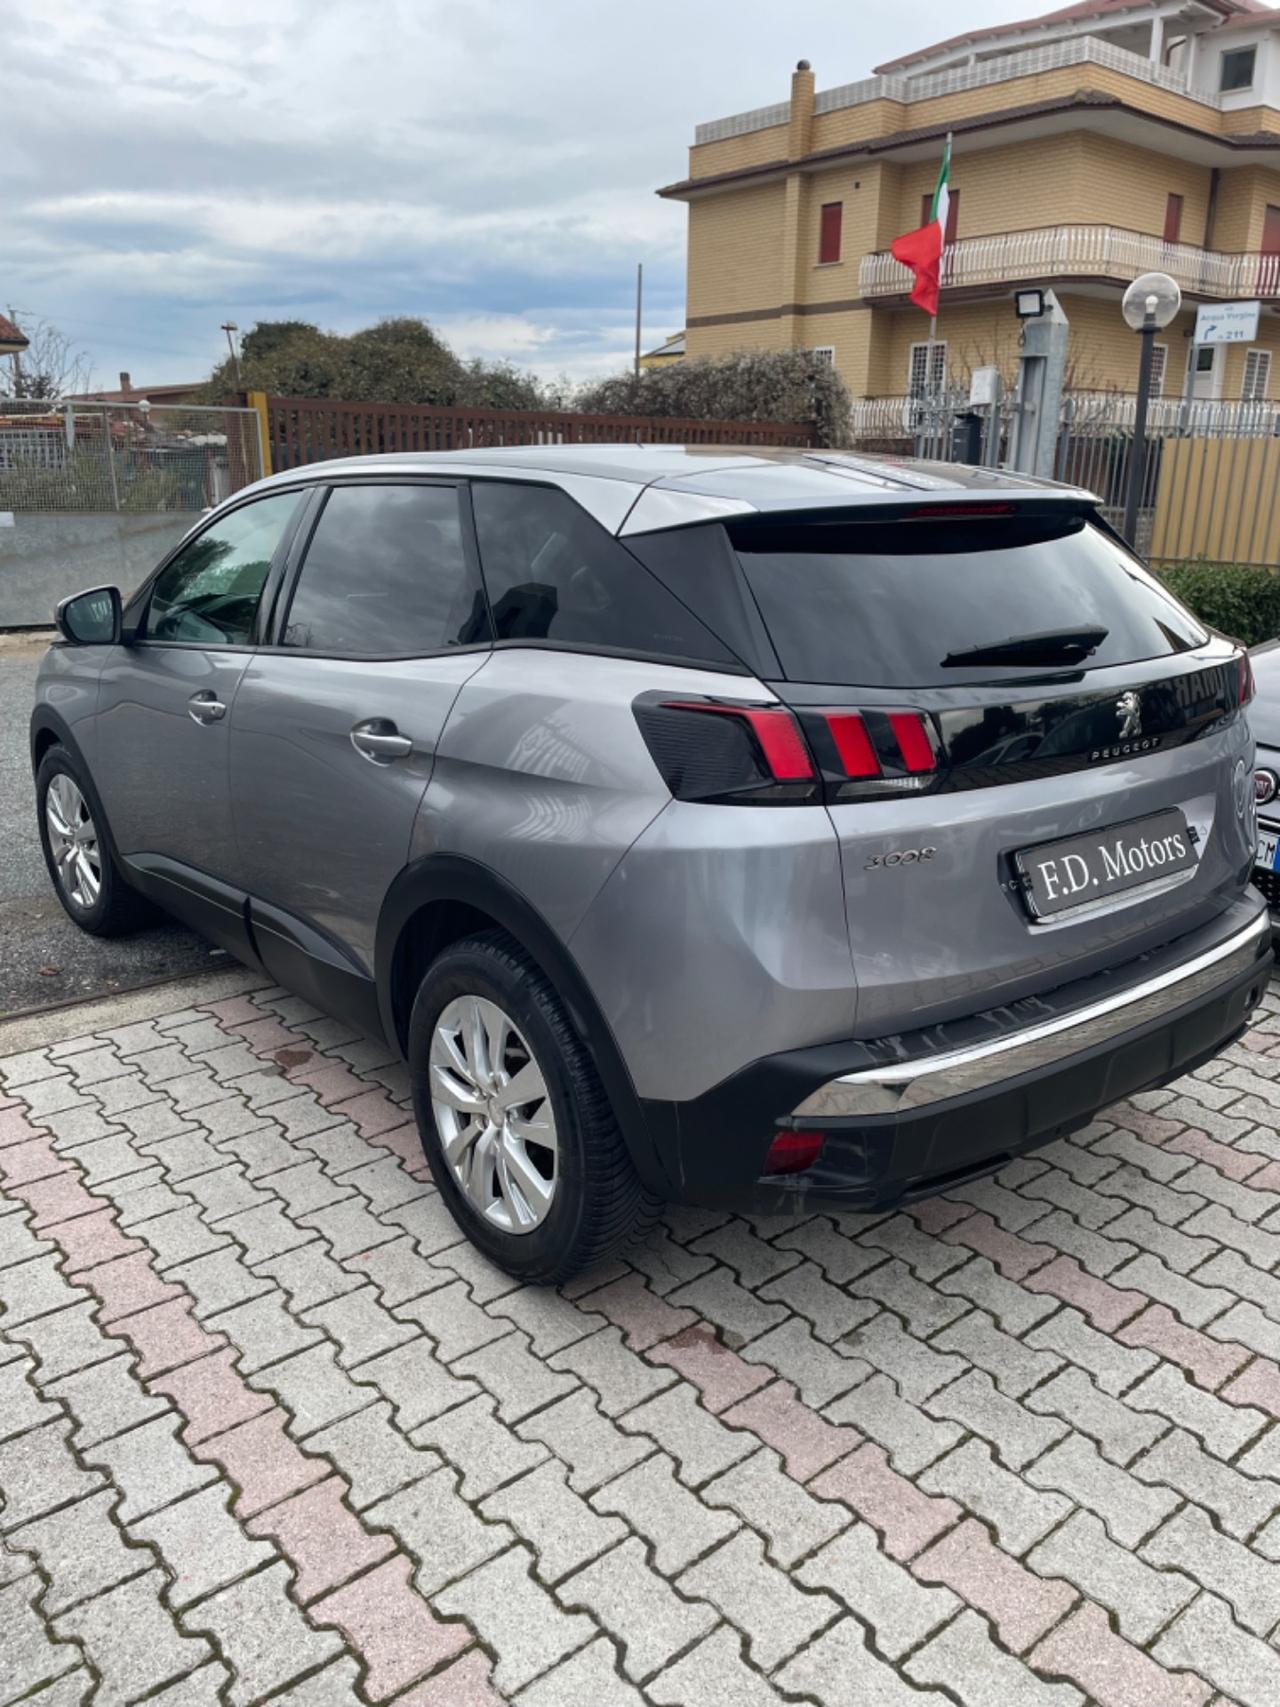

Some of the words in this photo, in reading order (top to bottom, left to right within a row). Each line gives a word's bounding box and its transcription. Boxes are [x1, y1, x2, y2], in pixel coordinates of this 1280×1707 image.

[1225, 330, 1244, 340] 211
[1091, 737, 1159, 761] PEUGEOT
[863, 846, 937, 871] 3008
[1037, 853, 1099, 900] F.D.
[1098, 833, 1187, 881] Motors
